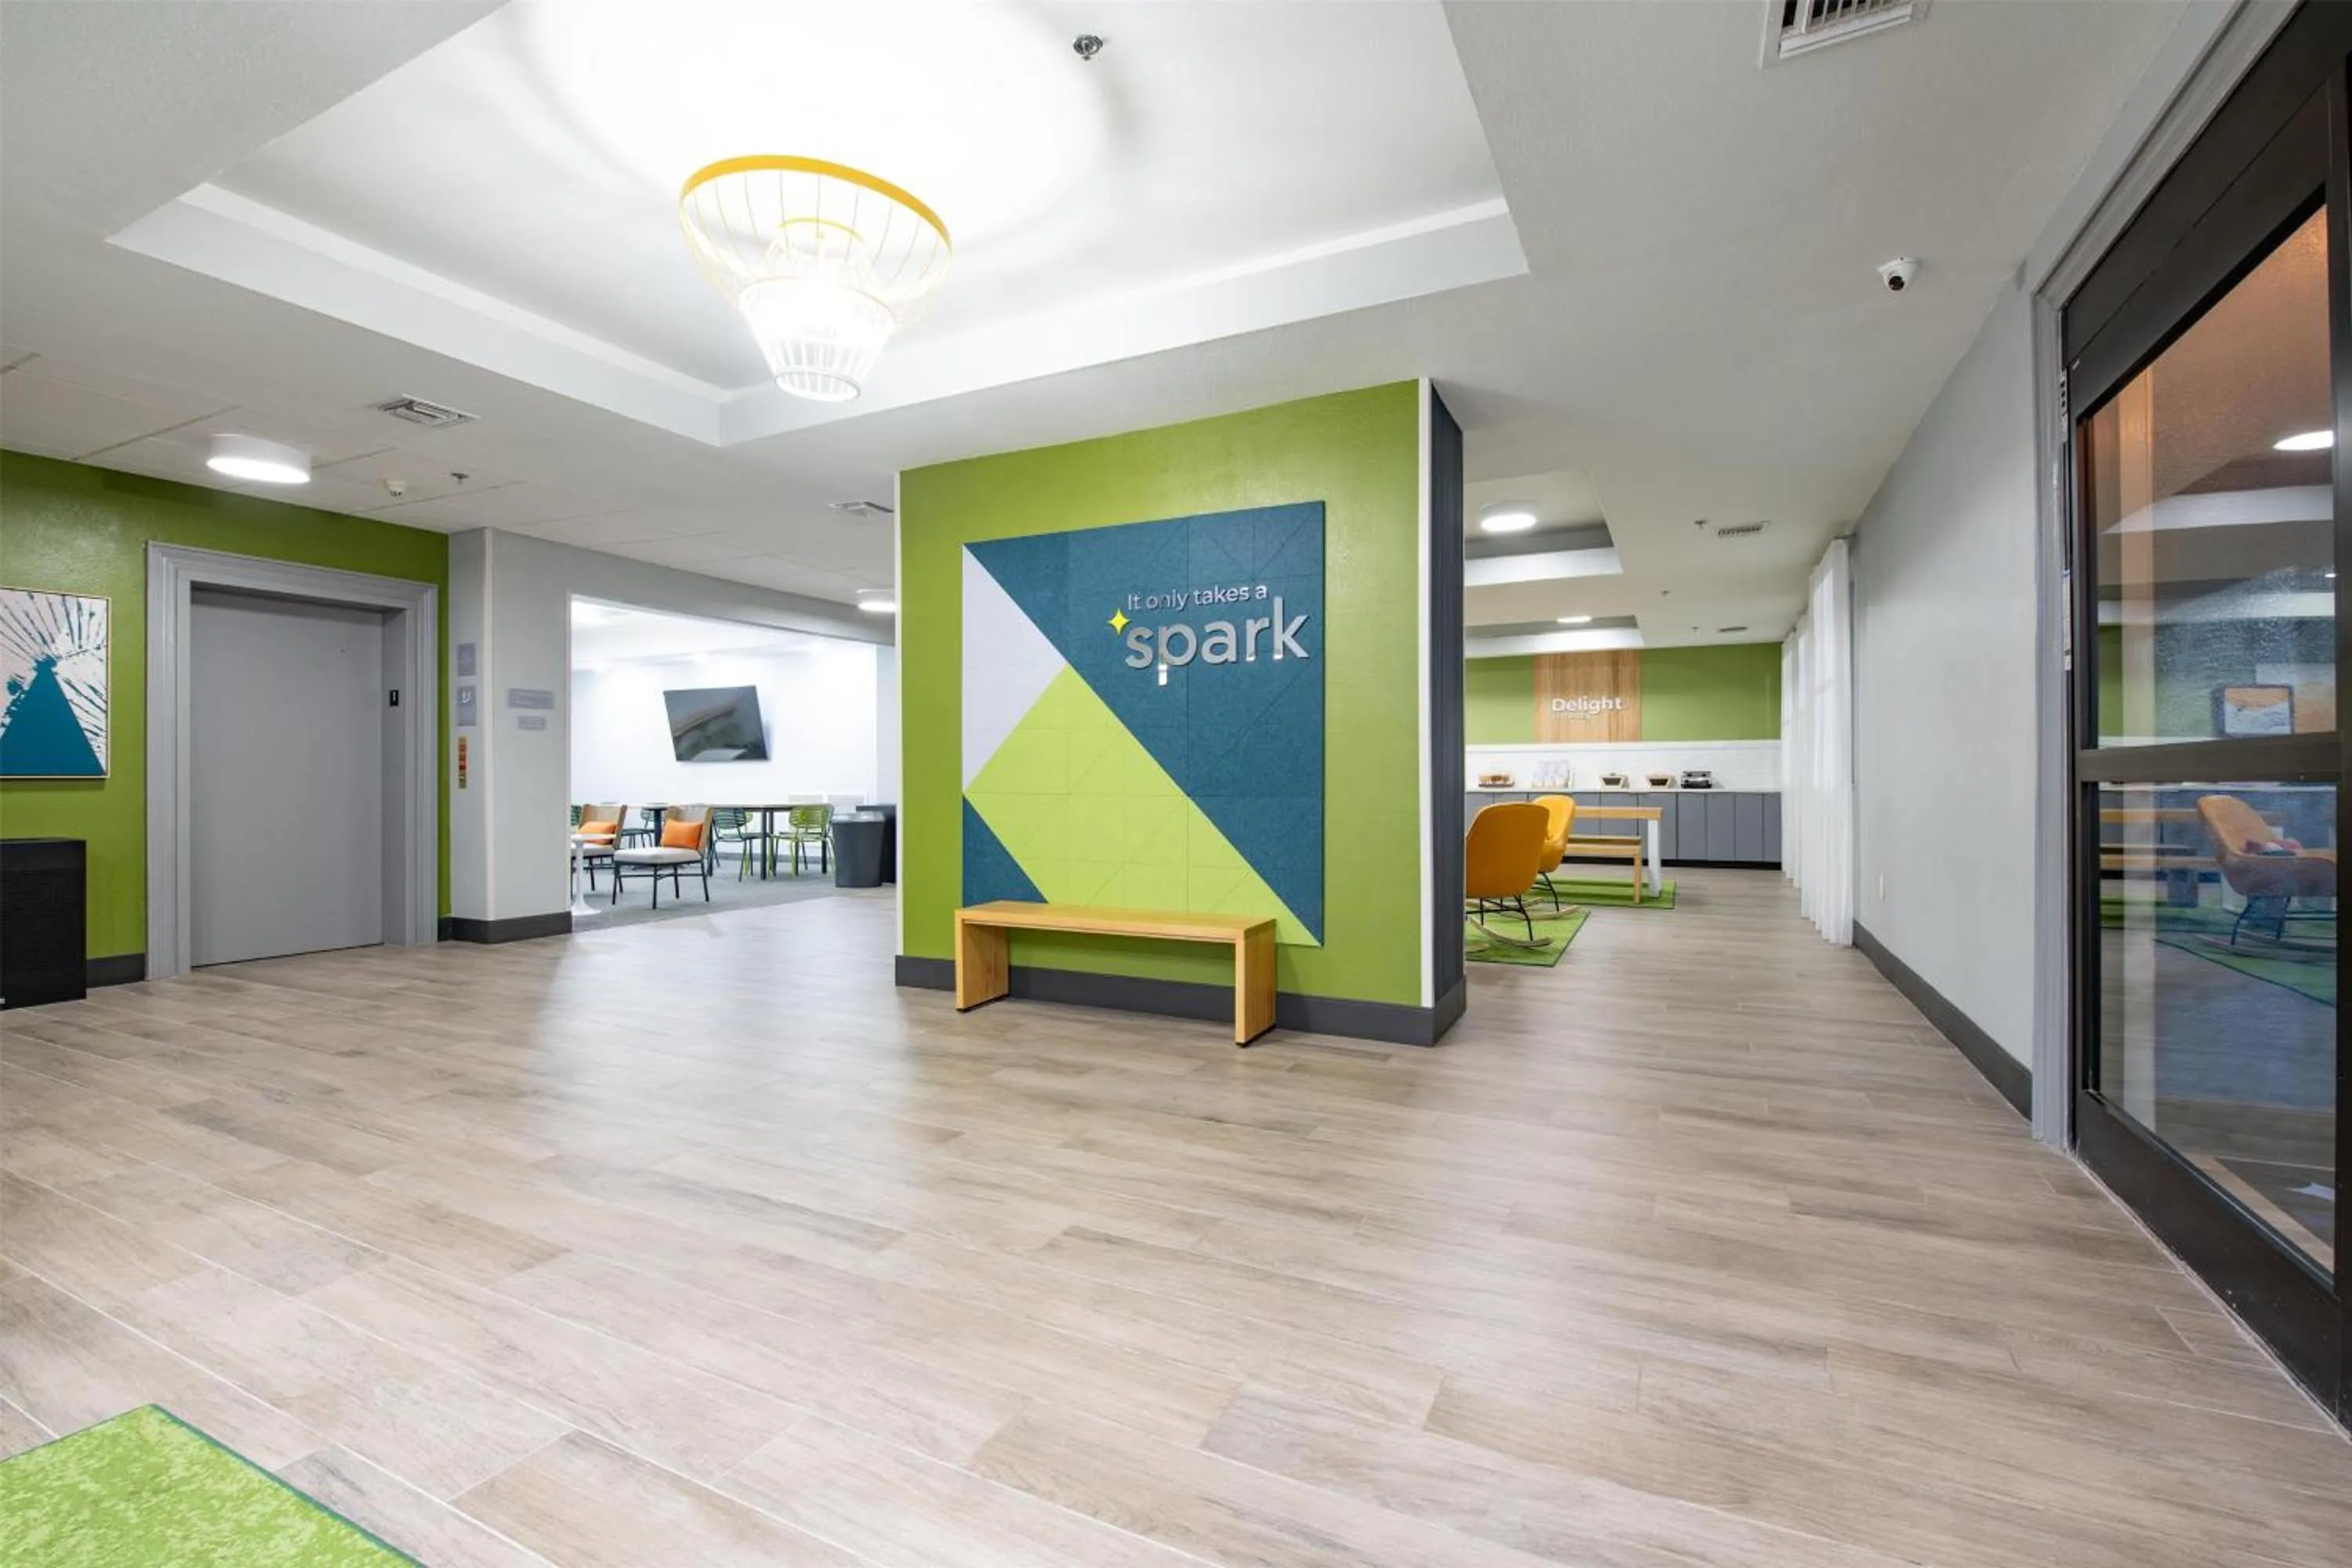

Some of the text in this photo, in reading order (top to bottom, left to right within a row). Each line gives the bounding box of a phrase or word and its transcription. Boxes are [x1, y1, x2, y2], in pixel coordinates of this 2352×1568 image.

[1127, 584, 1269, 612] It only takes a
[1125, 596, 1309, 686] spark
[1552, 695, 1622, 715] Delight
